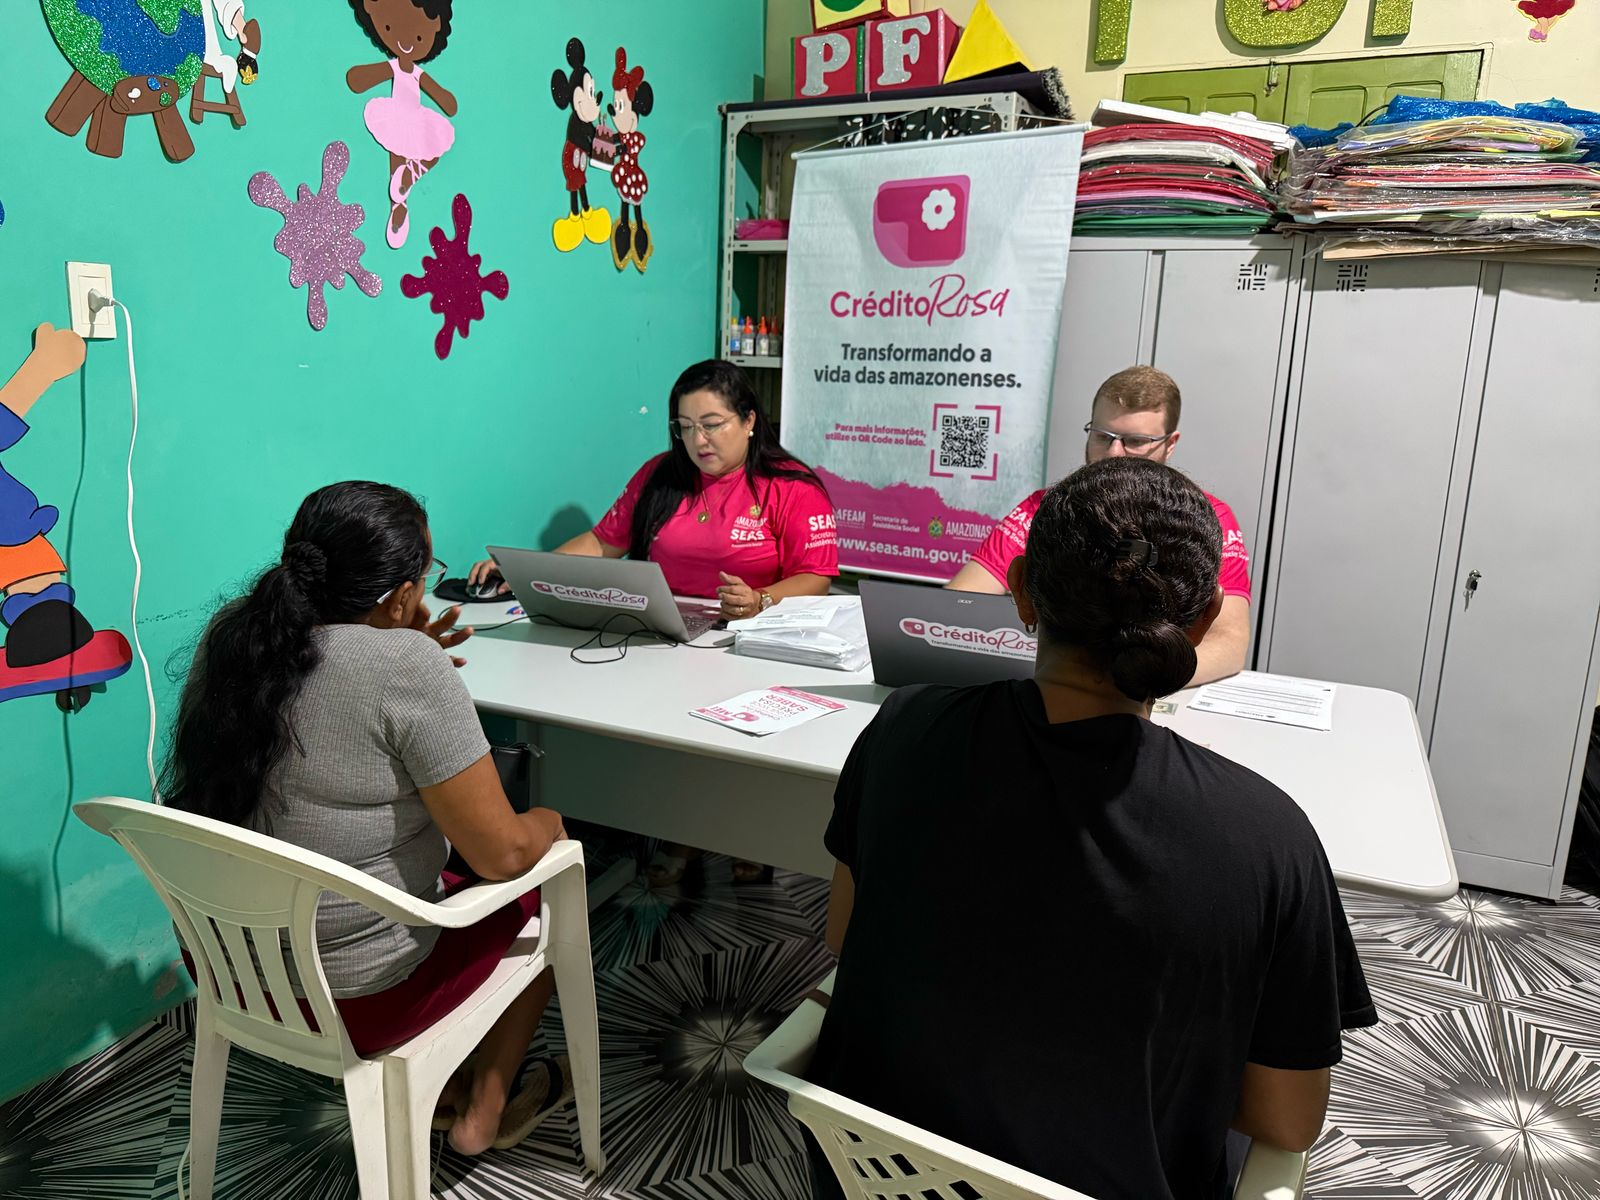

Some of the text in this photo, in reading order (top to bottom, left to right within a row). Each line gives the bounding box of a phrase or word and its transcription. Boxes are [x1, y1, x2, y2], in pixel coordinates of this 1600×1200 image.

[801, 15, 931, 96] P F
[841, 343, 992, 362] Transformando a
[814, 365, 1022, 388] vida das amazonenses.
[825, 432, 850, 441] utilize
[858, 434, 871, 443] QR
[872, 435, 893, 445] Code
[905, 436, 926, 447] lado.
[835, 423, 926, 438] Para mais informações,
[1008, 507, 1033, 532] EAS
[730, 528, 765, 541] SEAS
[945, 521, 992, 539] AMAZONAS
[929, 625, 1037, 651] CréditoRos
